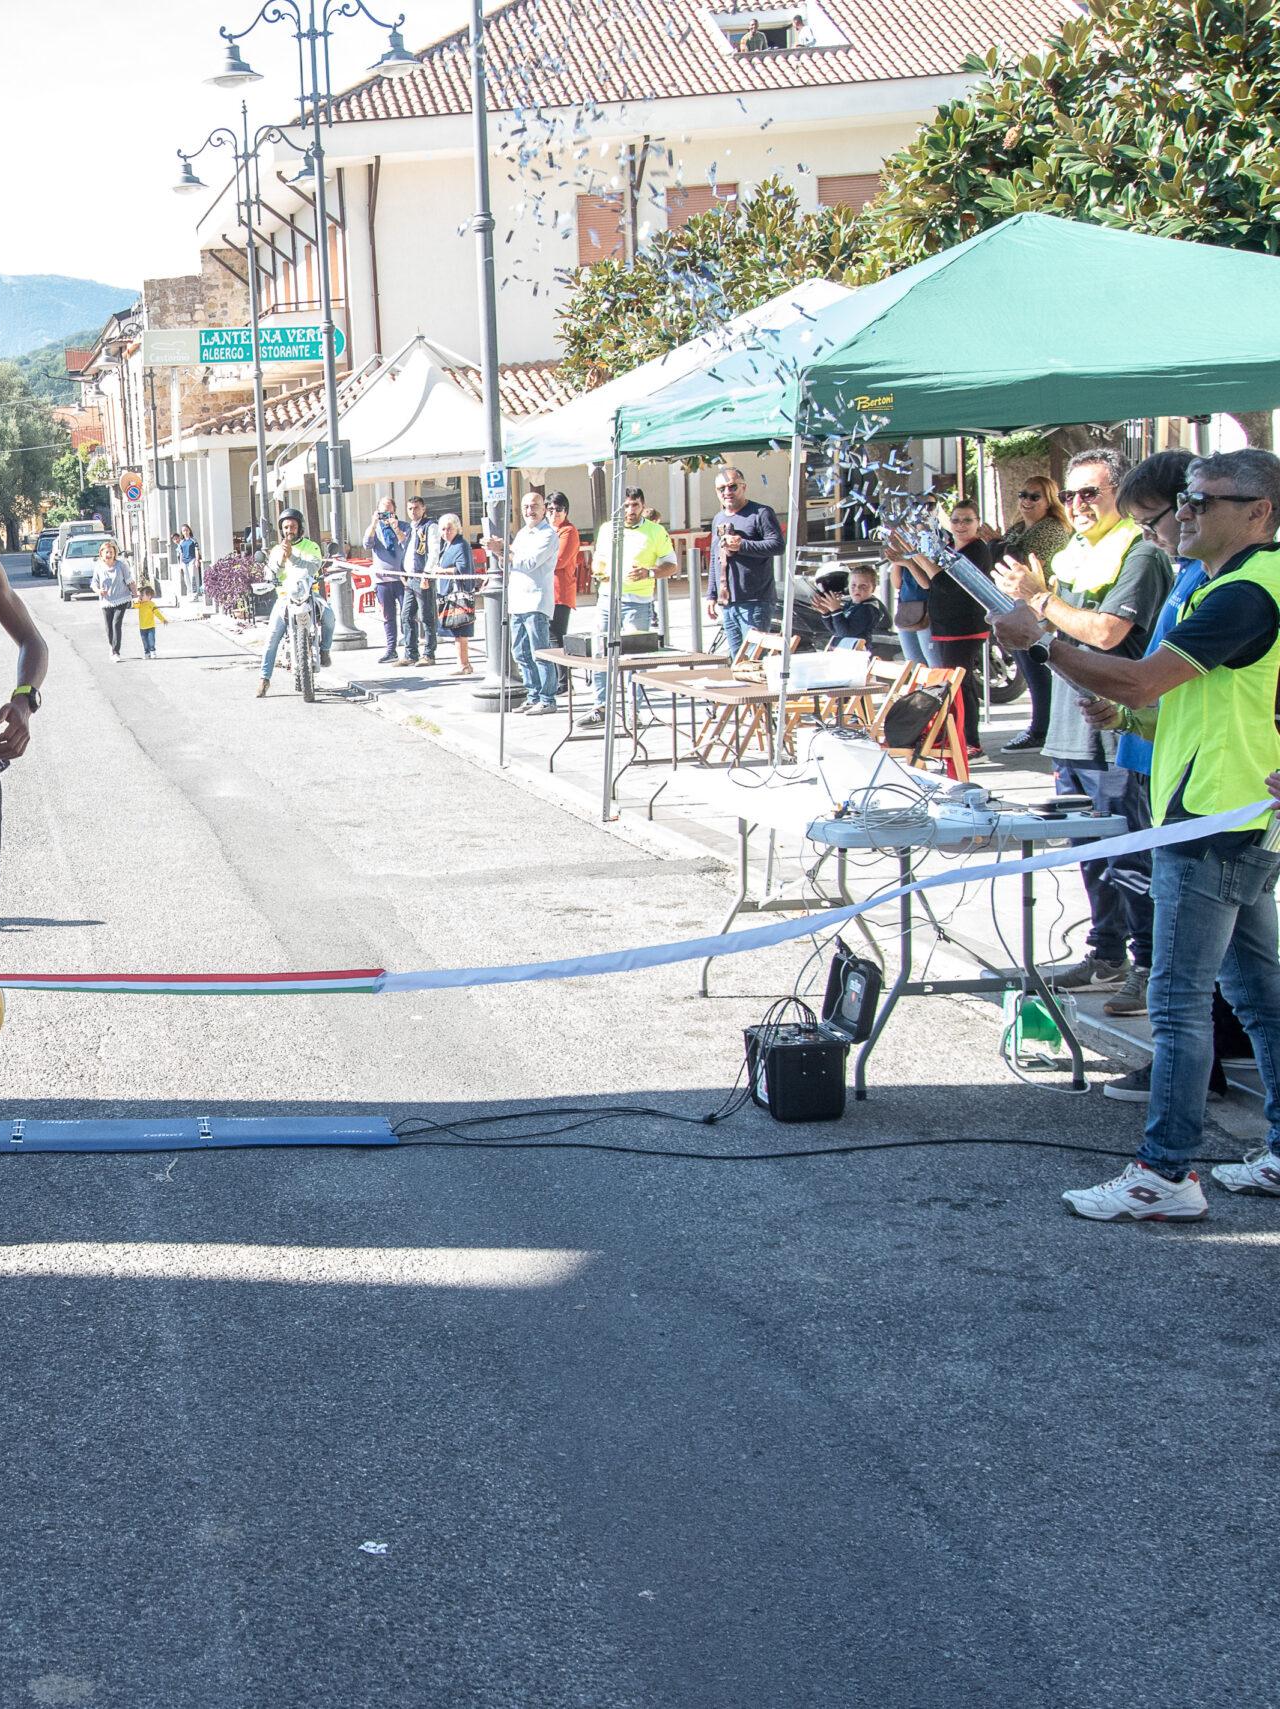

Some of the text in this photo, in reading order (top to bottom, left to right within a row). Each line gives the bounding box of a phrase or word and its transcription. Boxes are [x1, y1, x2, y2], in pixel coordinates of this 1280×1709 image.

[201, 329, 282, 346] LANTENA
[202, 347, 244, 361] ALBERGO
[259, 345, 310, 359] ISTORANTE
[854, 393, 893, 410] Bertoni
[489, 472, 501, 487] P
